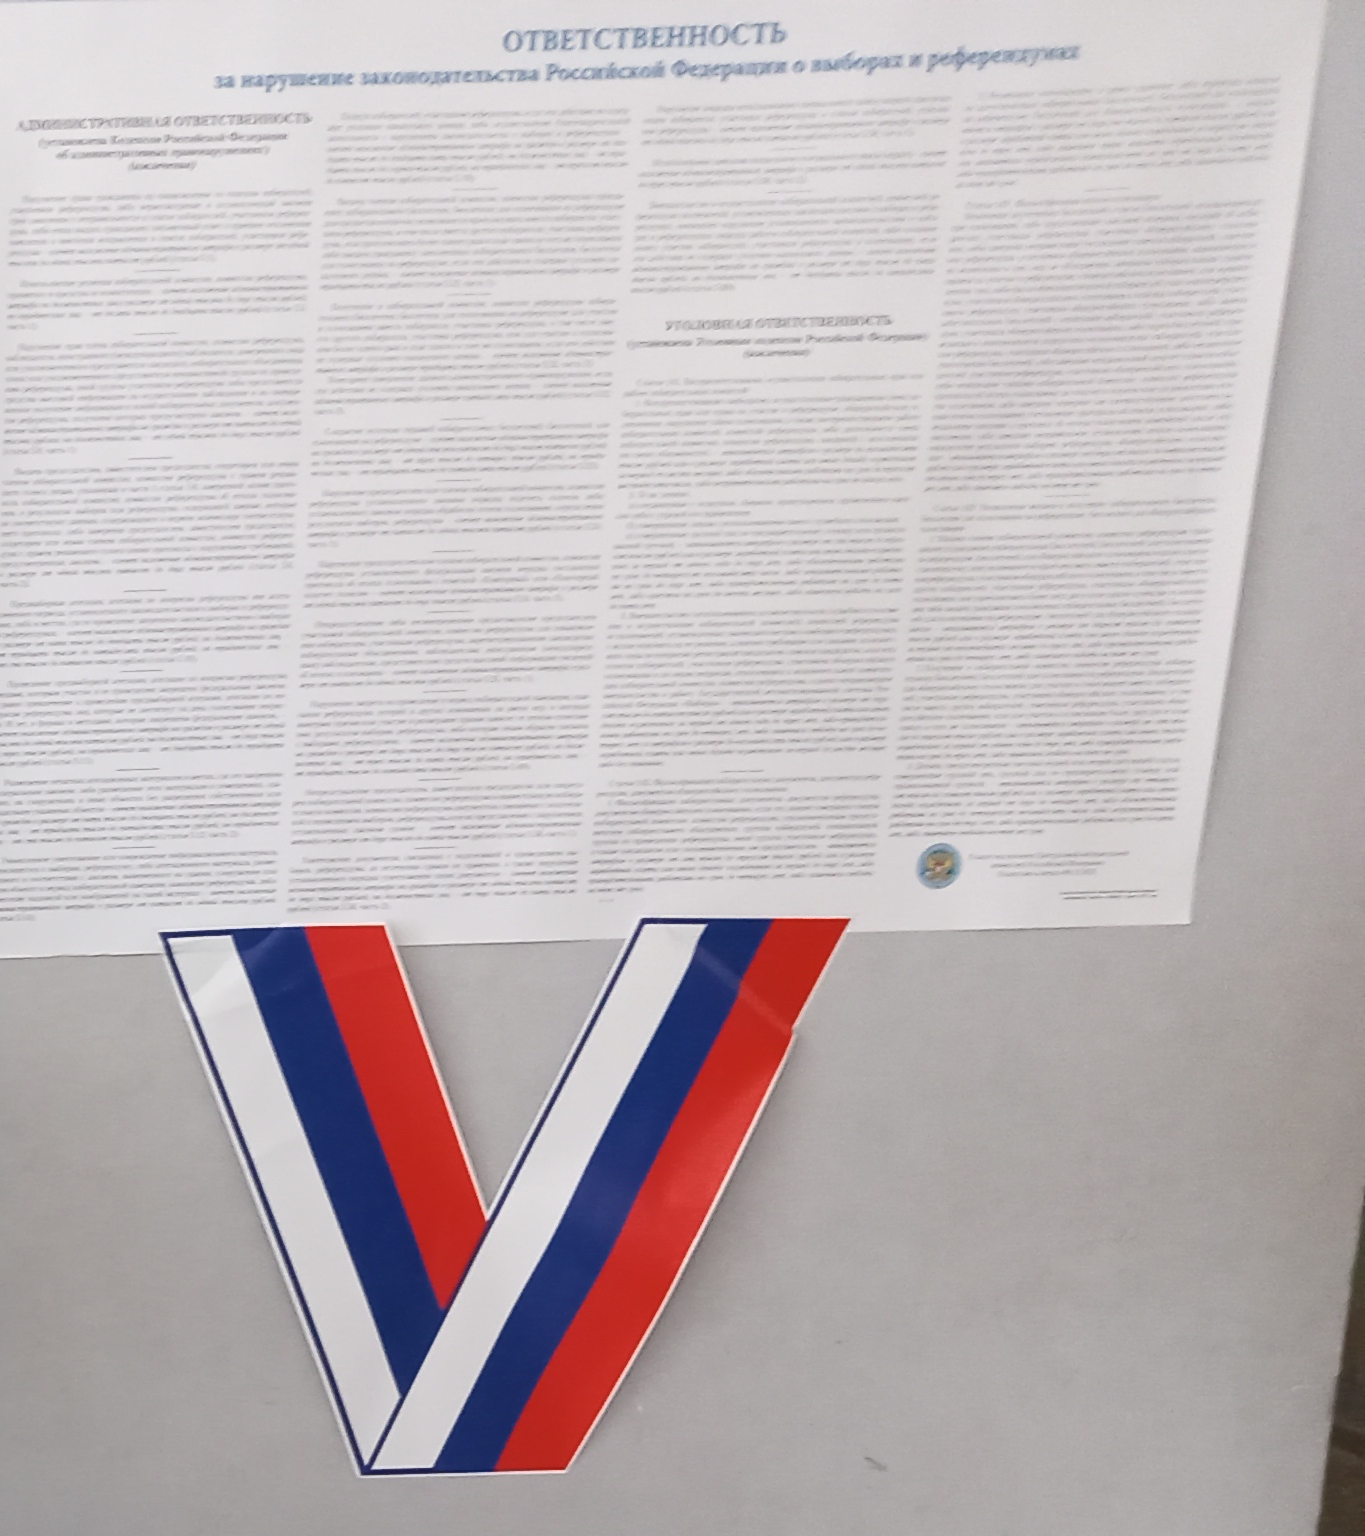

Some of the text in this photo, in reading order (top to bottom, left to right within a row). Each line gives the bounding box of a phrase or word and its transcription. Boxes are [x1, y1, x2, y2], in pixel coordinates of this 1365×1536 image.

[502, 22, 787, 53] ОТВЕТСТВЕННОСТЬ
[214, 45, 1080, 93] за нарушение законодательства Российской Федерации о выборах и референдумах
